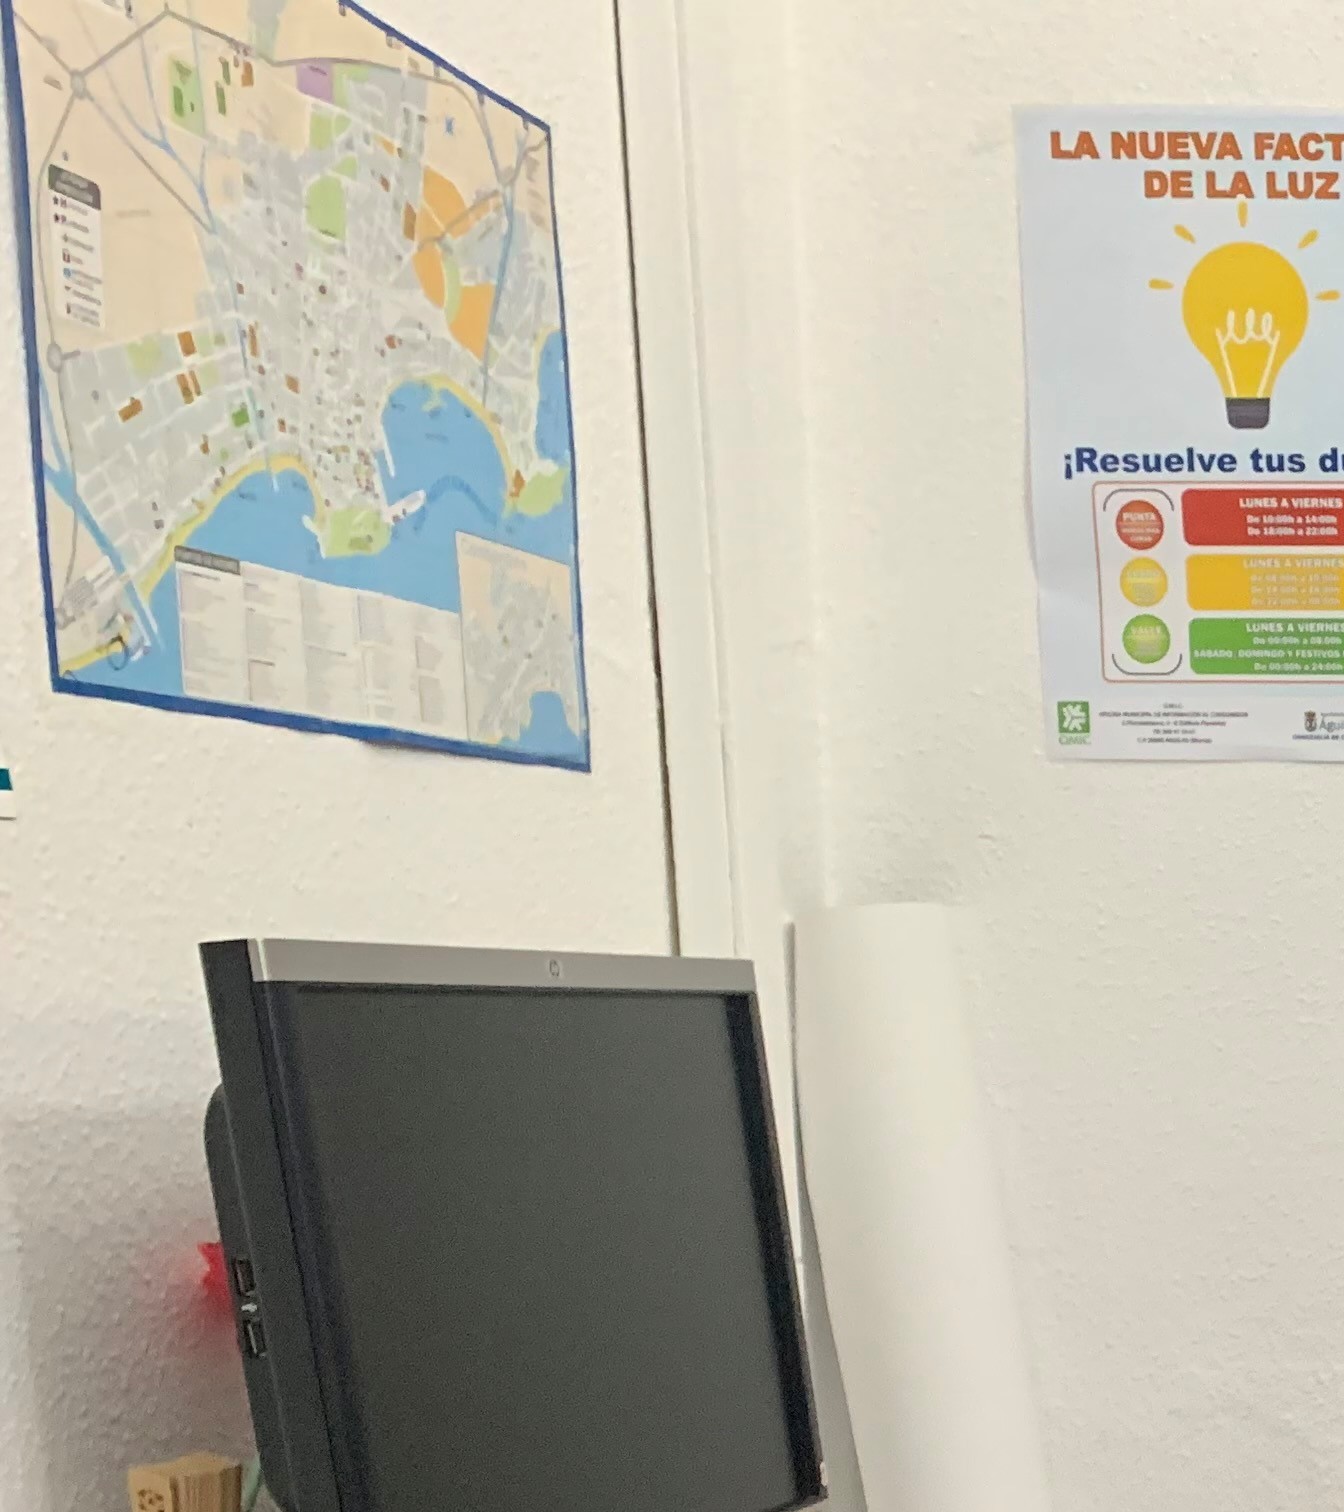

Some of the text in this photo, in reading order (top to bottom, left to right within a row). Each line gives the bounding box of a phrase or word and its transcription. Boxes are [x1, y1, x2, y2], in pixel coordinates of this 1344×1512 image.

[1051, 131, 1098, 160] LA
[1111, 132, 1242, 160] NUEVA
[1144, 171, 1340, 200] DE LA LUZ
[1063, 447, 1237, 480] ¡Resuelve
[1251, 450, 1306, 473] tus
[1239, 497, 1343, 509] LUNES A VIERNES
[1243, 558, 1344, 568] LUNES A VIERNES
[1246, 623, 1283, 633] LUNES
[1286, 623, 1294, 633] A
[1295, 650, 1341, 659] FESTIVOS
